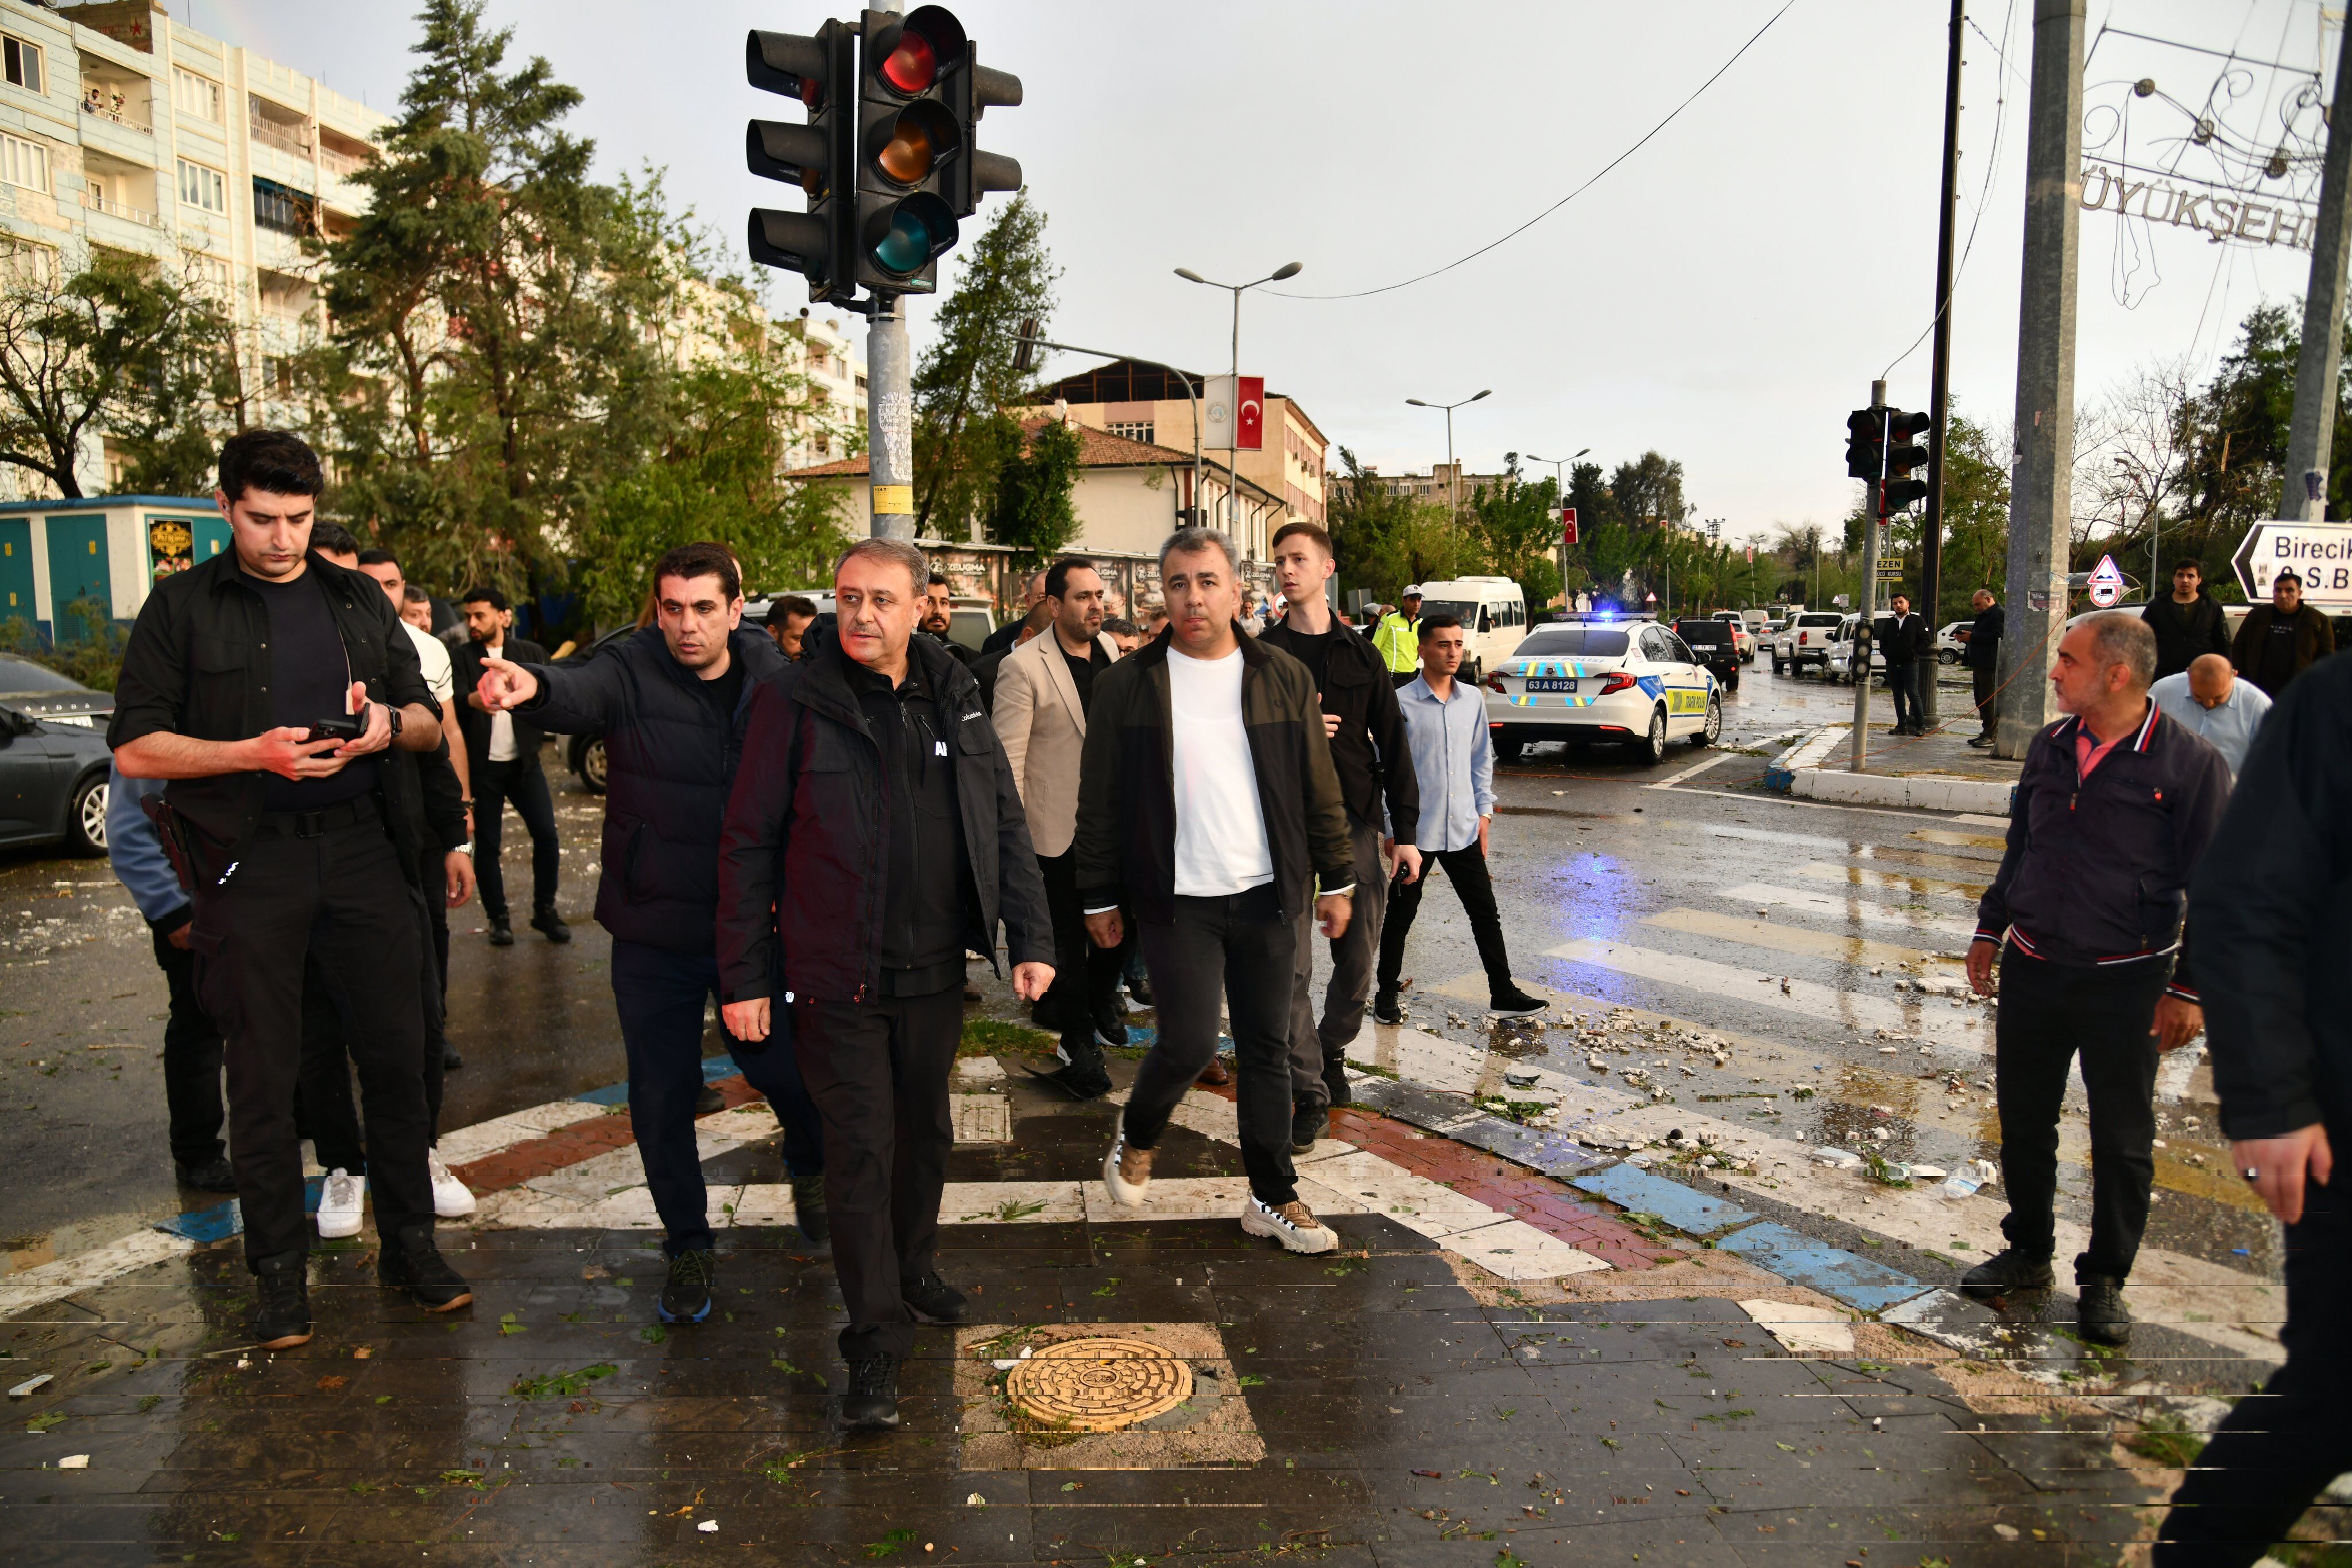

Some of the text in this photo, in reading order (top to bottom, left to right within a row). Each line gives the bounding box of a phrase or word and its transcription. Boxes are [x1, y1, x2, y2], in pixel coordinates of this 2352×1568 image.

[947, 563, 985, 571] ZEUGMA
[1529, 681, 1575, 690] 63 A 8128
